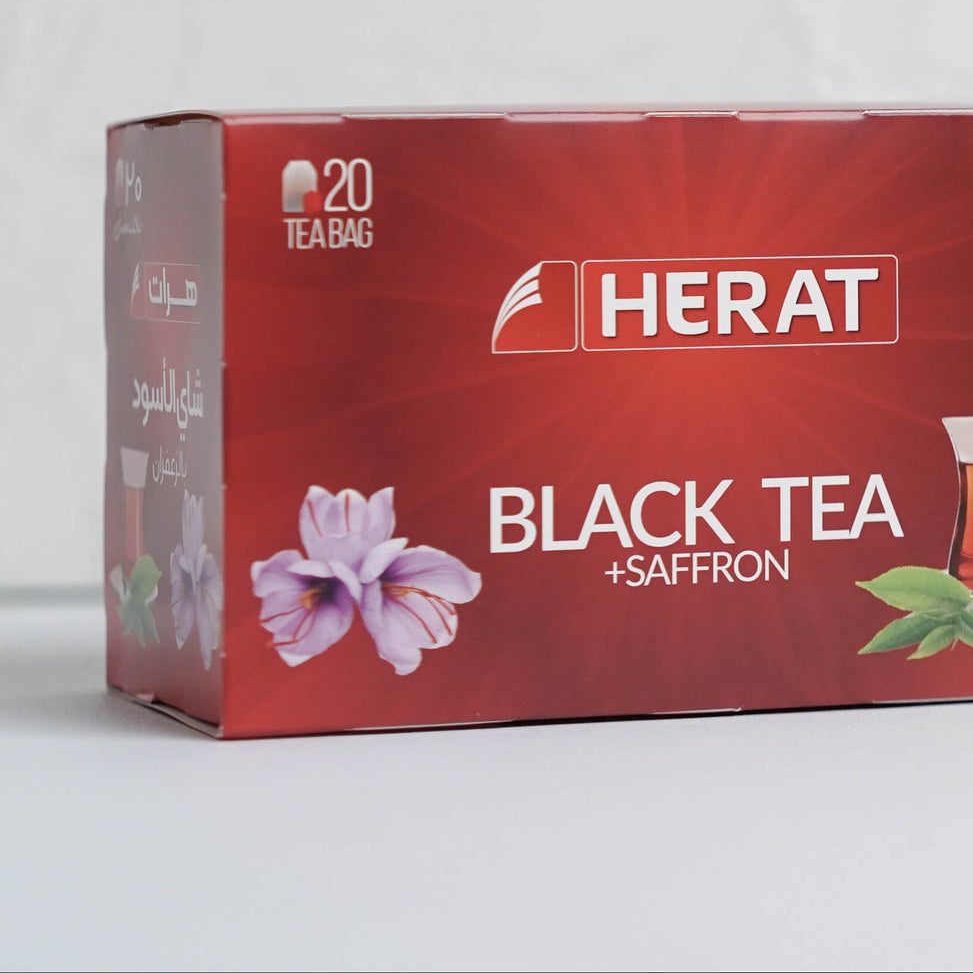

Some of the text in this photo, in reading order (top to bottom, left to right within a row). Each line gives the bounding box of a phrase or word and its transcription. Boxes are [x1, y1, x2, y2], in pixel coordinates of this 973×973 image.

[323, 158, 373, 212] 20
[282, 217, 374, 250] TEA BAG
[601, 267, 880, 338] HERAT
[176, 368, 204, 441] شاي
[489, 473, 905, 554] BLACK TEA
[604, 548, 790, 588] +SAFFRON
